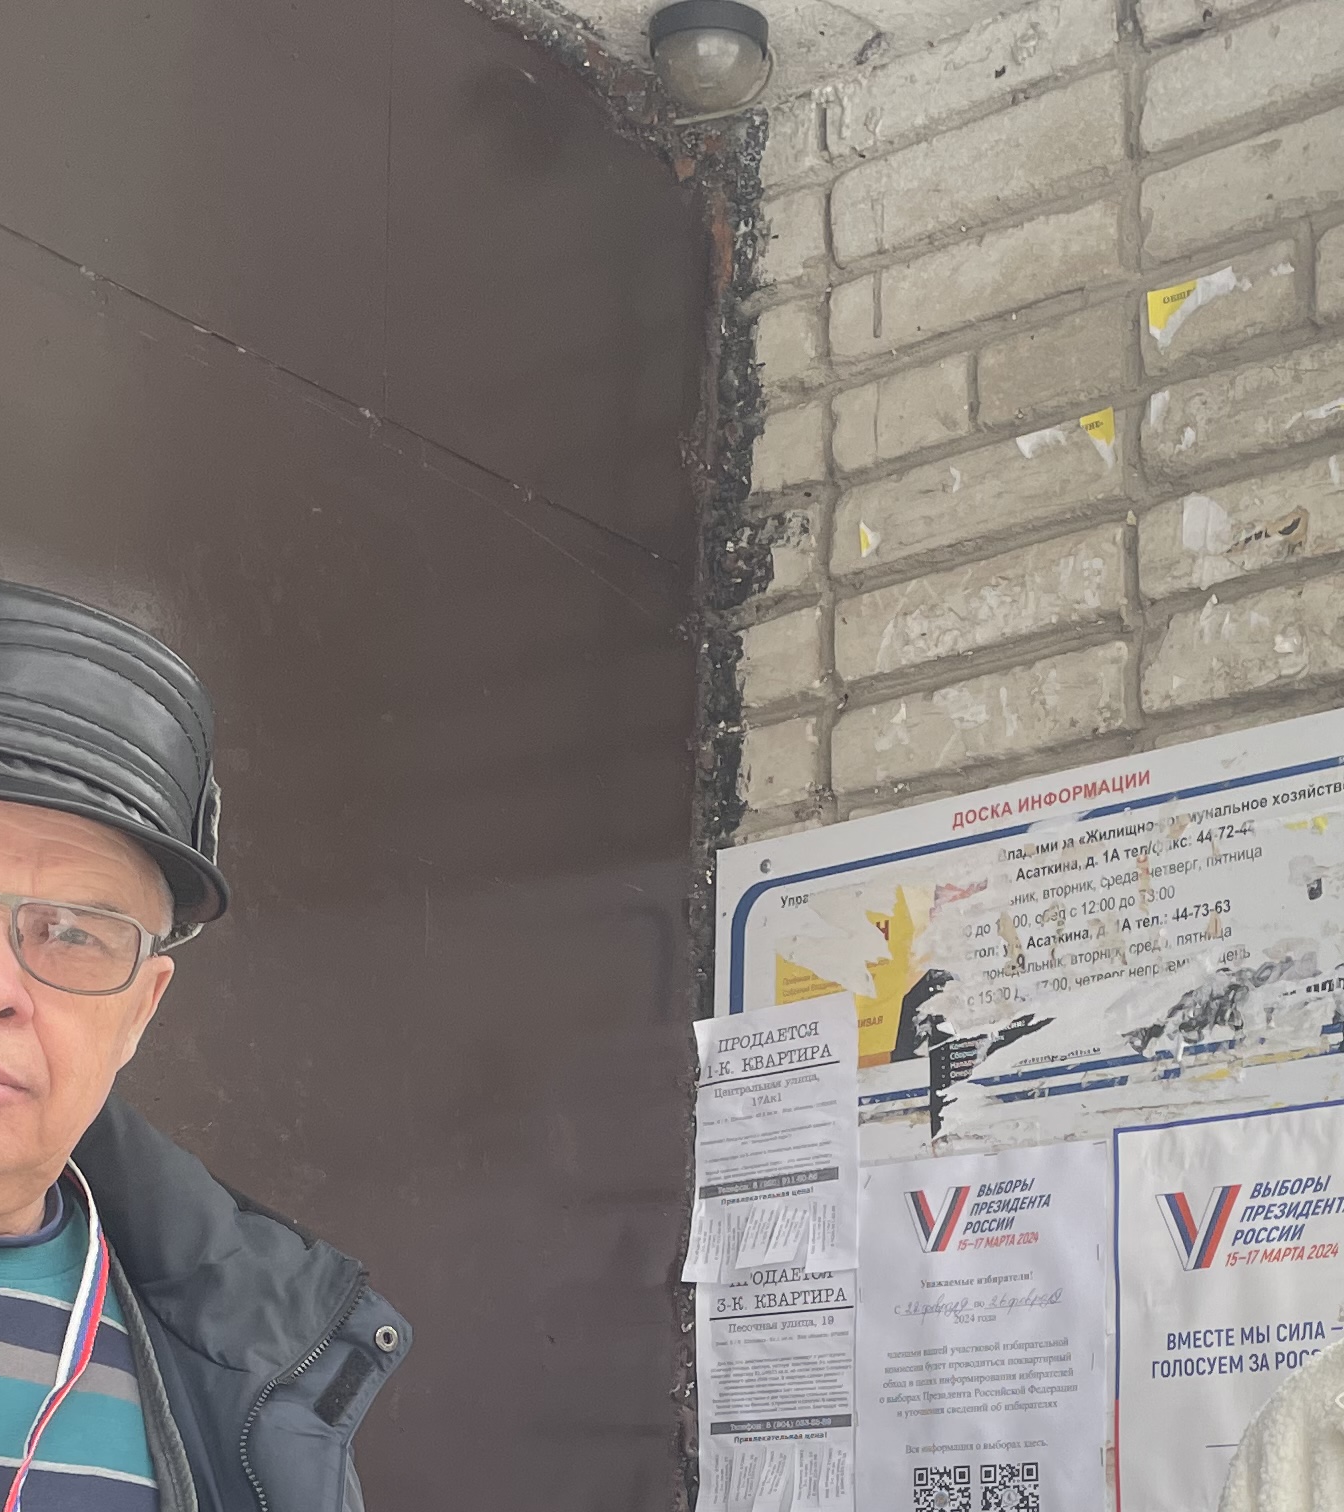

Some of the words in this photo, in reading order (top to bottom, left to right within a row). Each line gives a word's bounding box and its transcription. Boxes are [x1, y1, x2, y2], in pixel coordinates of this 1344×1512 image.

[952, 801, 1013, 831] ДОСКА
[1017, 769, 1151, 814] ИНФОРМАЦИИ
[1015, 858, 1082, 882] Асаткина,
[1085, 855, 1099, 870] д.
[1103, 850, 1120, 864] 1А
[1043, 878, 1096, 900] вторник,
[1207, 847, 1263, 868] пятница
[975, 924, 991, 938] до
[1081, 897, 1116, 915] 12:00
[1118, 895, 1136, 912] до
[1171, 898, 1232, 922] 44-73-63
[718, 1021, 819, 1053] ПРОДАЕТСЯ
[707, 1060, 735, 1079] 1-К.
[742, 1044, 832, 1072] КВАРТИРА
[714, 1080, 782, 1098] Центральная
[784, 1073, 820, 1089] улица,
[976, 1177, 1036, 1198] ВЫБОРЫ
[1249, 1175, 1332, 1200] ВЫБОРЫ
[969, 1193, 1052, 1217] ПРЕЗИДЕНТА
[963, 1216, 1015, 1235] РОССИИ
[1231, 1223, 1306, 1247] РОССИИ
[985, 1233, 1016, 1248] МАРТА
[1017, 1231, 1039, 1246] 2024
[1260, 1244, 1305, 1263] МАРТА
[1307, 1242, 1339, 1261] 2024
[920, 1276, 975, 1289] Уважаемые
[977, 1270, 1034, 1286] избиратели!
[716, 1296, 748, 1312] 3-К.
[754, 1287, 847, 1310] КВАРТИРА
[728, 1321, 778, 1334] Песочная
[780, 1317, 817, 1332] улица,
[954, 1314, 975, 1325] 2024
[977, 1315, 997, 1324] года
[950, 1342, 1000, 1357] участковой
[1002, 1337, 1069, 1352] избирательной
[1166, 1327, 1235, 1351] ВМЕСТЕ
[1240, 1325, 1270, 1345] МЫ
[1276, 1320, 1326, 1343] СИЛА
[949, 1357, 1005, 1371] проводиться
[1007, 1352, 1072, 1367] поквартирный
[1151, 1354, 1244, 1379] ГОЛОСУЕМ
[1249, 1352, 1270, 1373] ЗА
[939, 1373, 1017, 1387] информирования
[1018, 1368, 1074, 1382] избирателей
[886, 1393, 921, 1405] выборах
[922, 1389, 972, 1402] Президента
[974, 1385, 1026, 1398] Российской
[1028, 1383, 1078, 1397] Федерации
[946, 1403, 988, 1415] сведений
[921, 1442, 974, 1455] информация
[983, 1439, 1021, 1451] выборах
